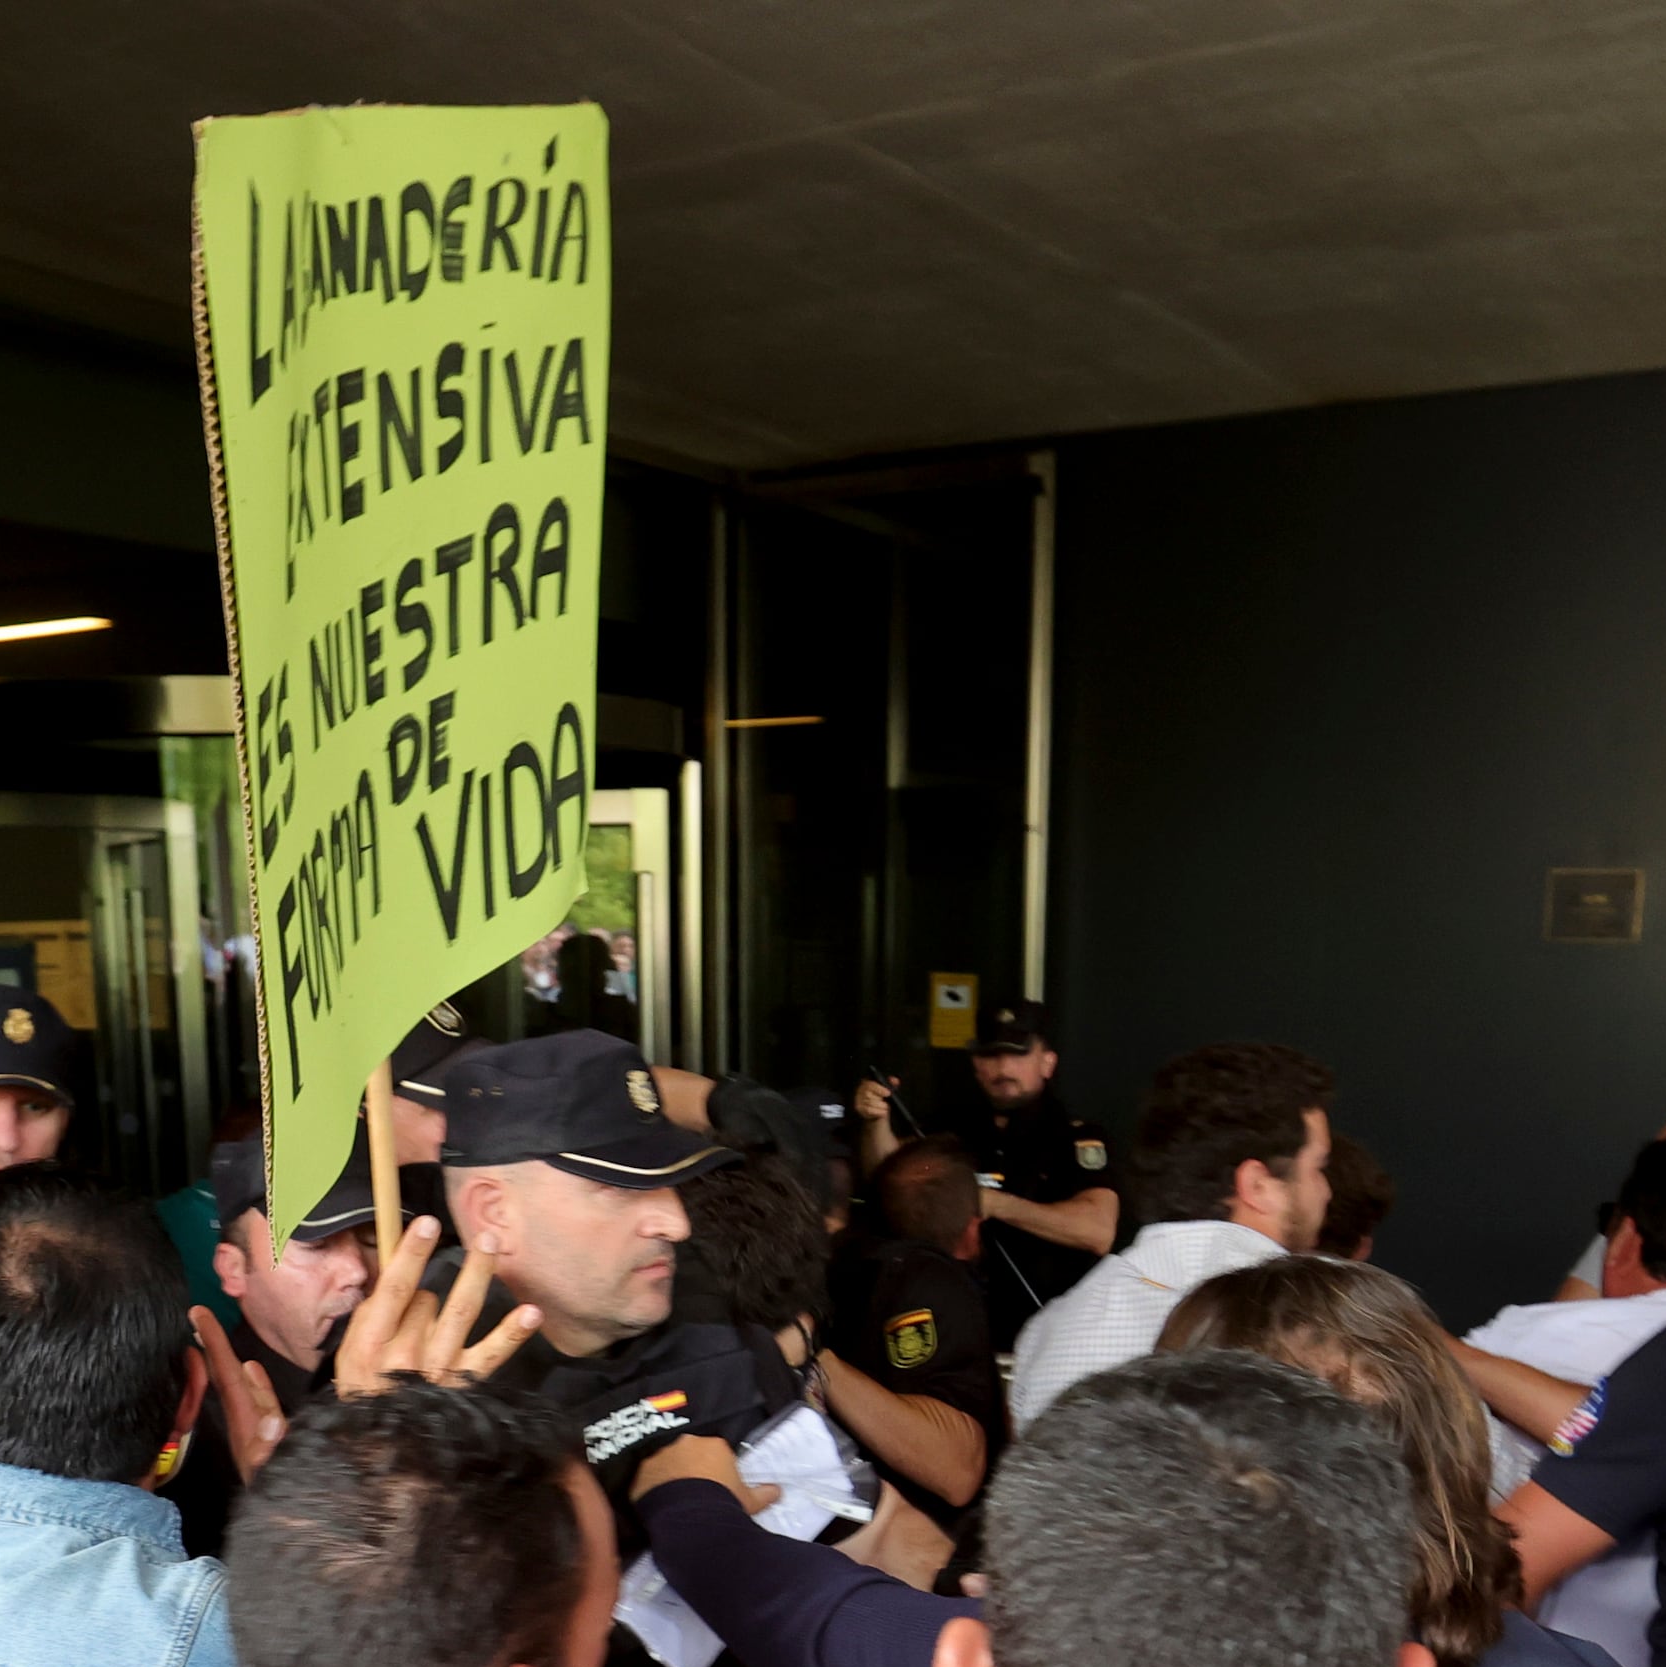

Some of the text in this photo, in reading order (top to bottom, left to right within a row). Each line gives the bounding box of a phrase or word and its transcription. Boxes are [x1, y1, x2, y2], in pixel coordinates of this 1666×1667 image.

[257, 496, 571, 873] ES NUESTRA
[277, 690, 587, 1104] FORMA DE VIDA
